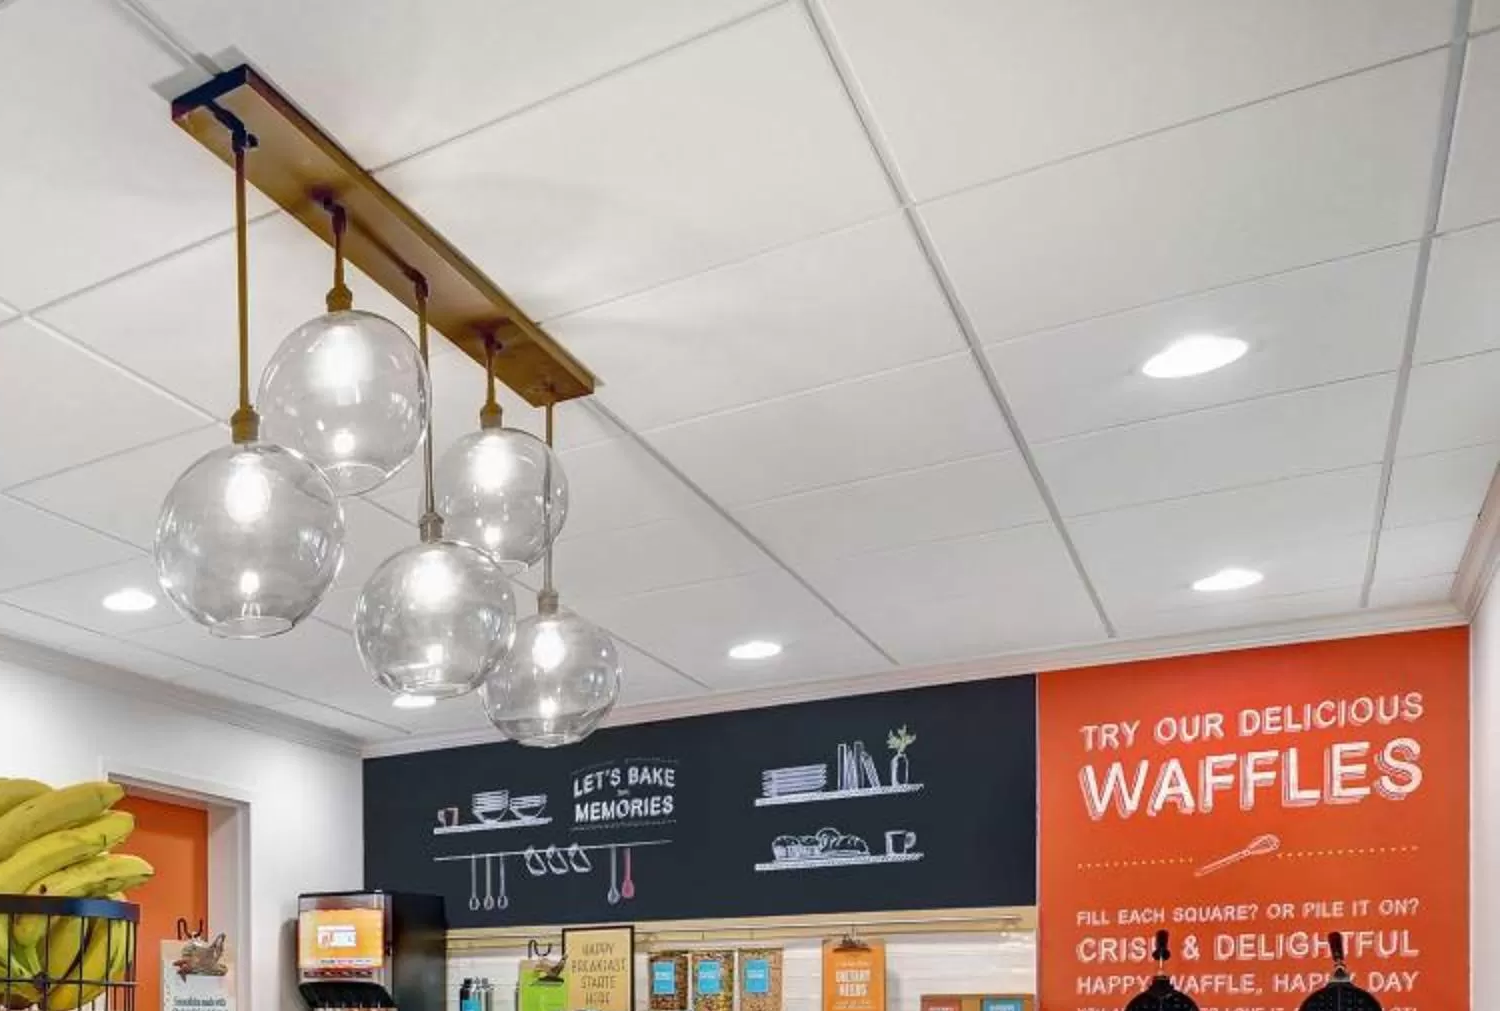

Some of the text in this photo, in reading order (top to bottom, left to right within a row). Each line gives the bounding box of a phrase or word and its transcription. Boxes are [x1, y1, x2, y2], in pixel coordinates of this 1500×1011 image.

[1080, 691, 1424, 751] TRY OUR DELICIOUS
[573, 766, 676, 798] LET'S BAKE
[1078, 737, 1424, 821] WAFFLES
[575, 795, 674, 823] MEMORIES
[1076, 897, 1420, 926] FILL EACH SQUARE? OR PILE IT ON?
[1181, 934, 1200, 961] &
[1076, 975, 1150, 996] HAPPY
[1273, 972, 1358, 994] HAP
[1367, 971, 1419, 993] DAY
